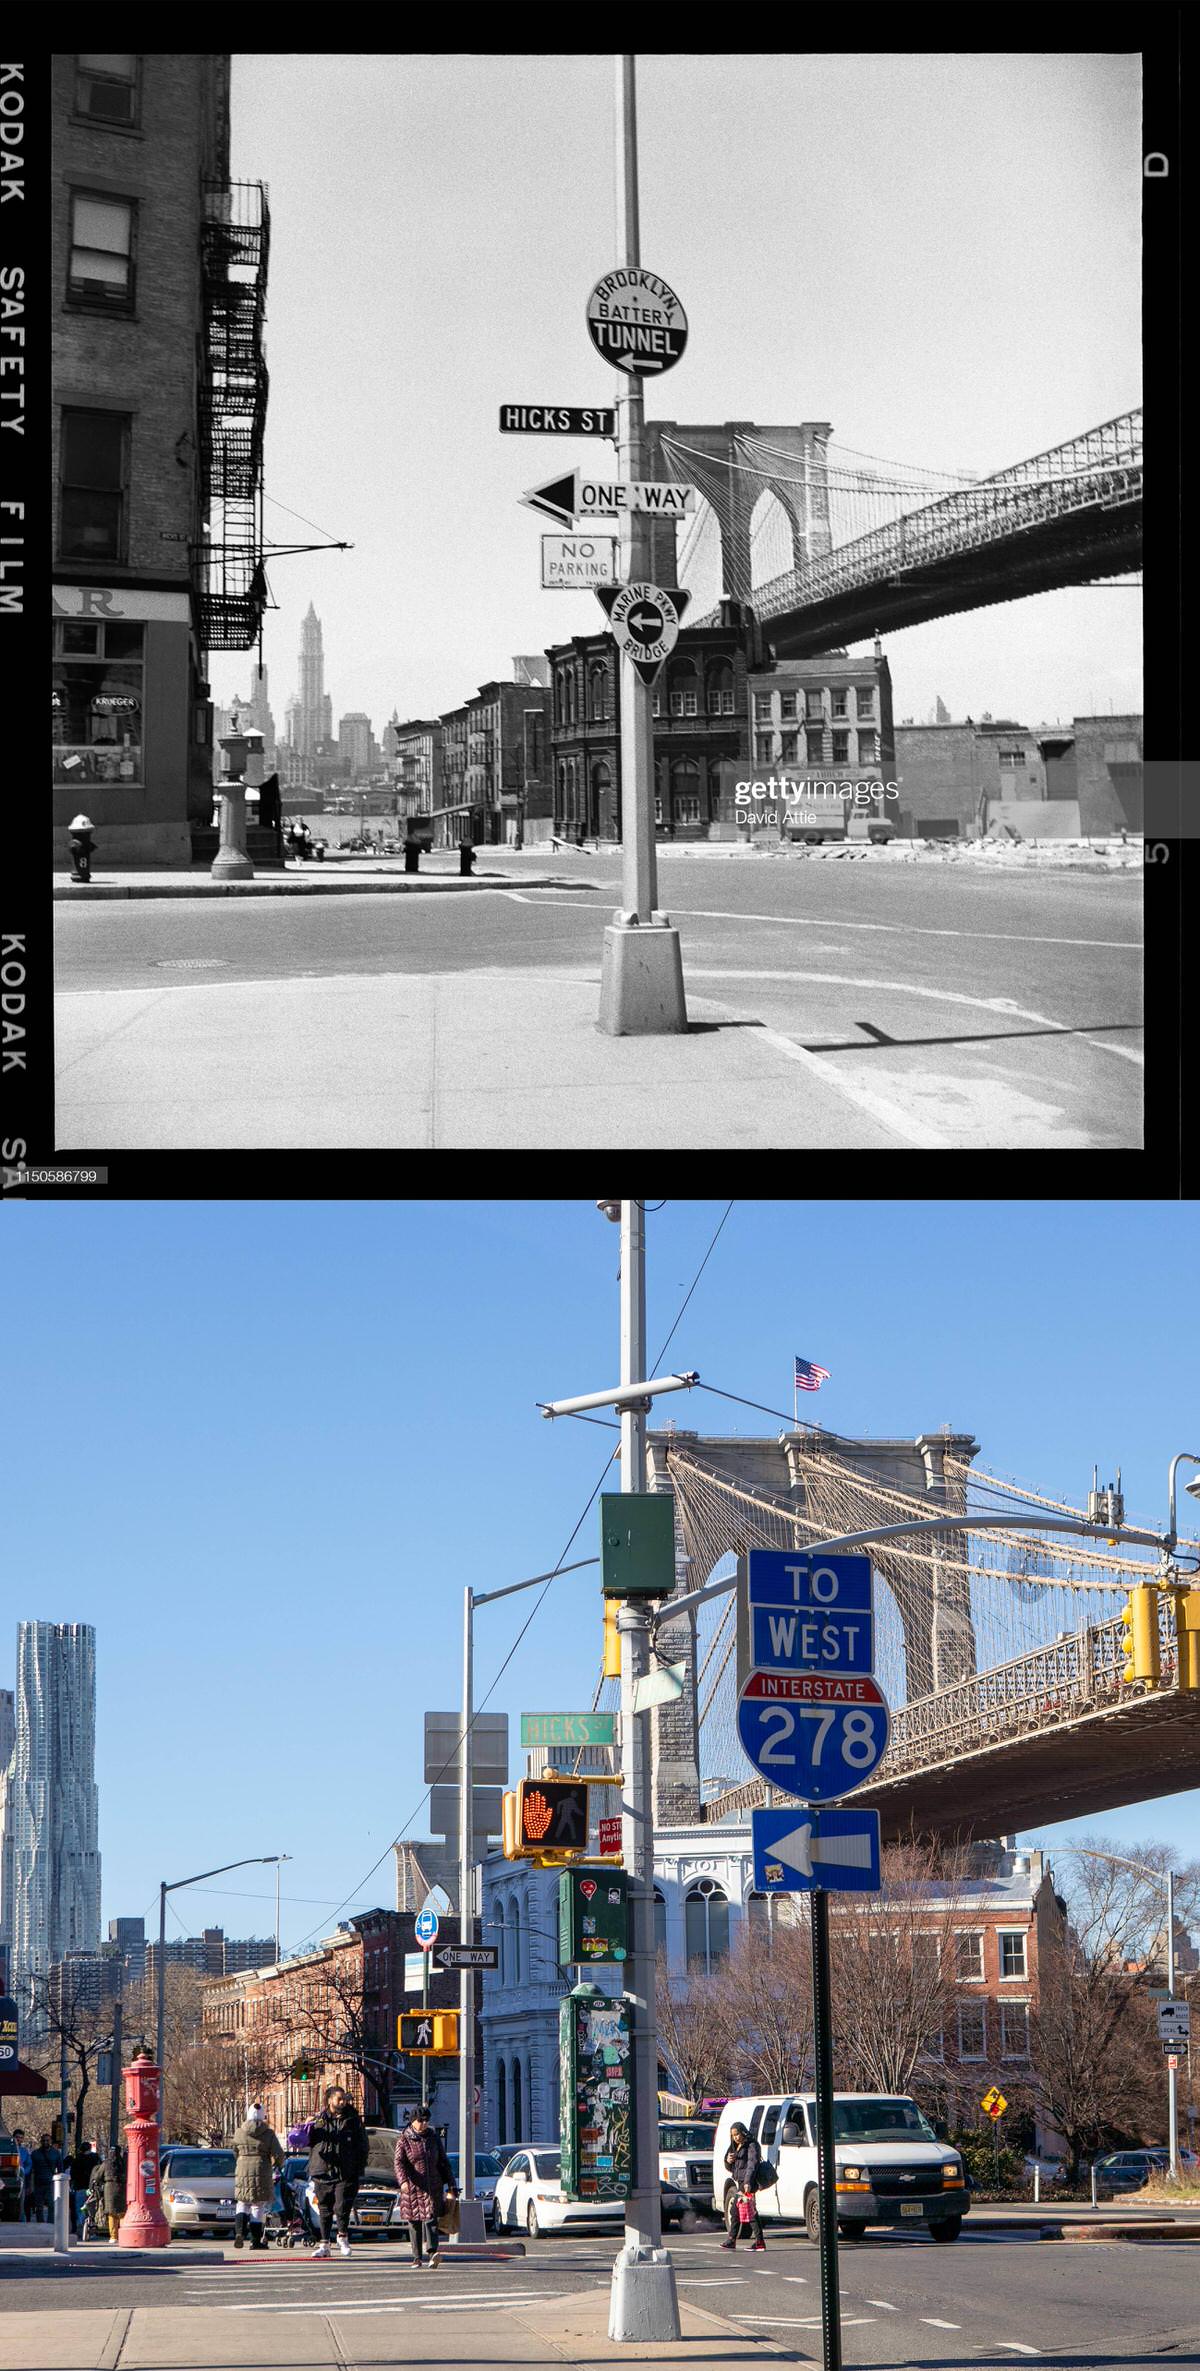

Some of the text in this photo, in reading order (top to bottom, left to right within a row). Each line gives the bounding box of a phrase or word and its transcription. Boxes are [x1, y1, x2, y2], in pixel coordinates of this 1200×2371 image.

[0, 63, 25, 203] KODAK
[1144, 152, 1169, 177] D
[596, 270, 678, 311] BROOKLYN
[599, 303, 674, 326] BATTERY
[593, 321, 679, 356] TUNNEL
[506, 407, 608, 432] HICKS ST
[582, 485, 691, 509] ONE WAY
[0, 501, 24, 613] FILM
[562, 543, 595, 558] NO
[549, 562, 608, 576] PARKING
[613, 585, 677, 625] MARINE PKWY
[623, 638, 669, 660] BRIDGE
[1, 934, 26, 1073] KODAK
[784, 1565, 839, 1603] TO
[768, 1616, 860, 1662] WEST
[762, 1678, 866, 1699] INTERSTATE
[527, 1717, 589, 1743] HICKS
[758, 1706, 877, 1769] 278
[602, 1823, 611, 1832] NO
[442, 1952, 490, 1962] ONE WAY
